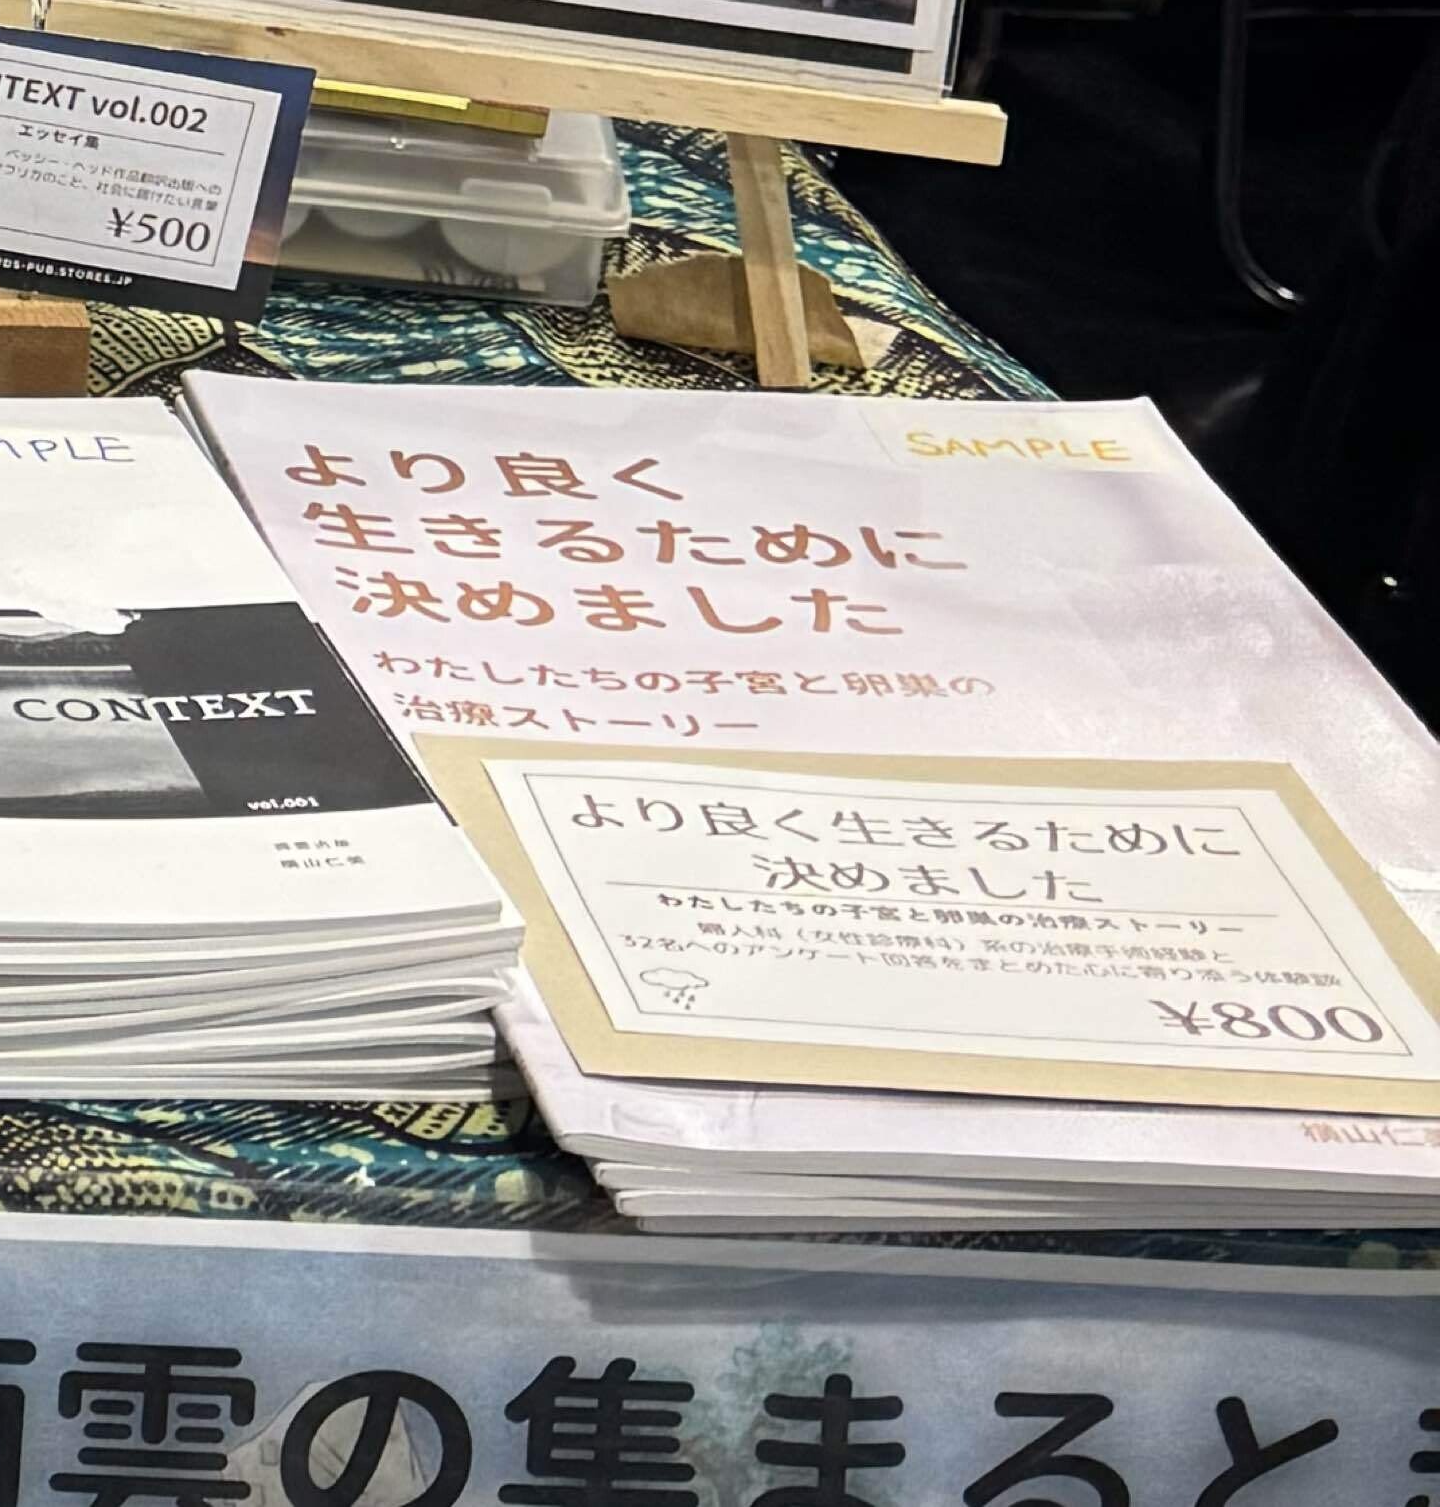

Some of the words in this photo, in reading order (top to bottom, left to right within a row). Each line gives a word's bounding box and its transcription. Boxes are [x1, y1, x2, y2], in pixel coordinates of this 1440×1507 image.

[90, 94, 209, 134] vol.002
[105, 206, 212, 253] ¥500
[906, 430, 1133, 465] SAMPLE
[283, 444, 684, 504] より良く
[300, 501, 970, 573] 生きるために
[340, 565, 906, 641] 決めました
[374, 647, 997, 702] わたしたちの子宮と卵巣の
[13, 688, 317, 724] CONTEXT
[394, 690, 761, 739] 治療ストーリー
[247, 796, 320, 810] vol.001
[570, 791, 1242, 860] より良く生きるために
[752, 852, 1104, 906] 決めました
[1150, 998, 1384, 1045] ¥800
